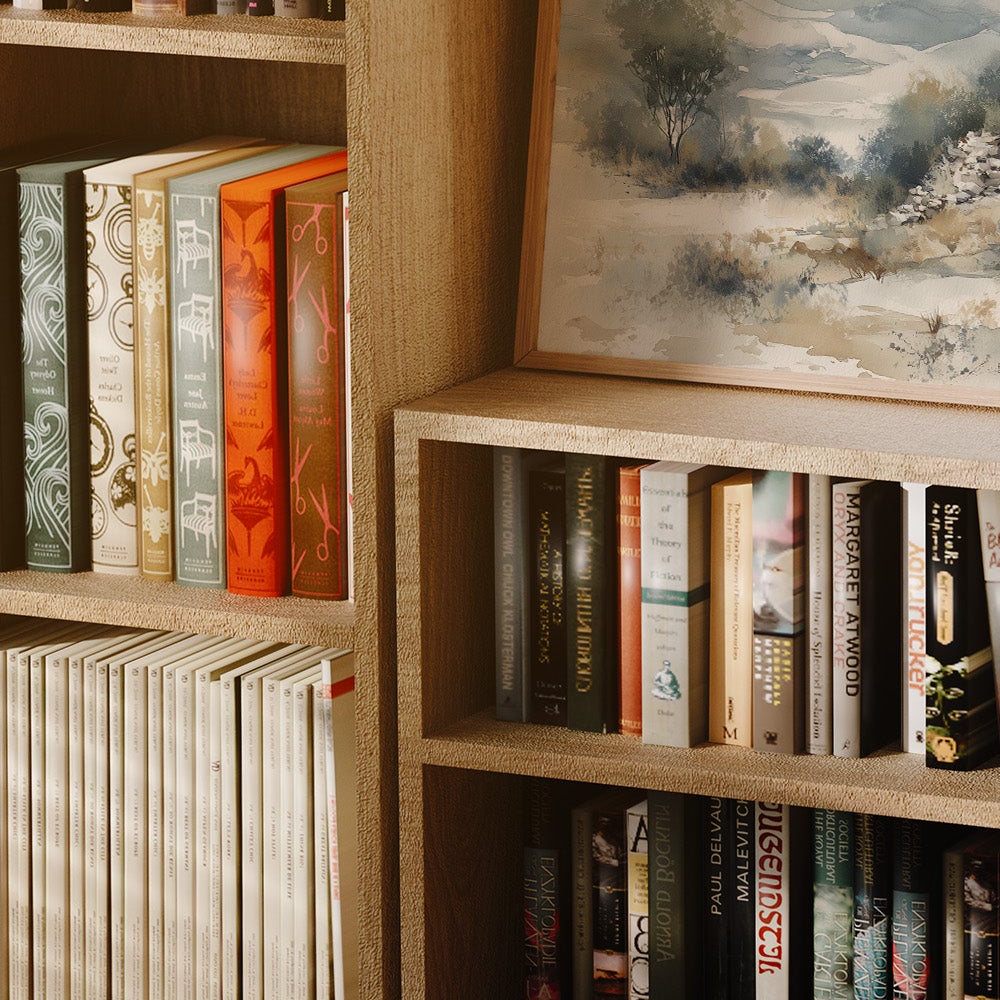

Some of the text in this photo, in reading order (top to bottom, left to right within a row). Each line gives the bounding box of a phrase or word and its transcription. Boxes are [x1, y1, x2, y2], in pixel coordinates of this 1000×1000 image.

[501, 455, 514, 691] DOWNTOWN OWL CHUCK KLOSTERMAN
[834, 491, 846, 669] ORYX AND CRAKE
[845, 493, 860, 697] MARGARET ATWOOD
[711, 796, 722, 916] PAUL DELVAU
